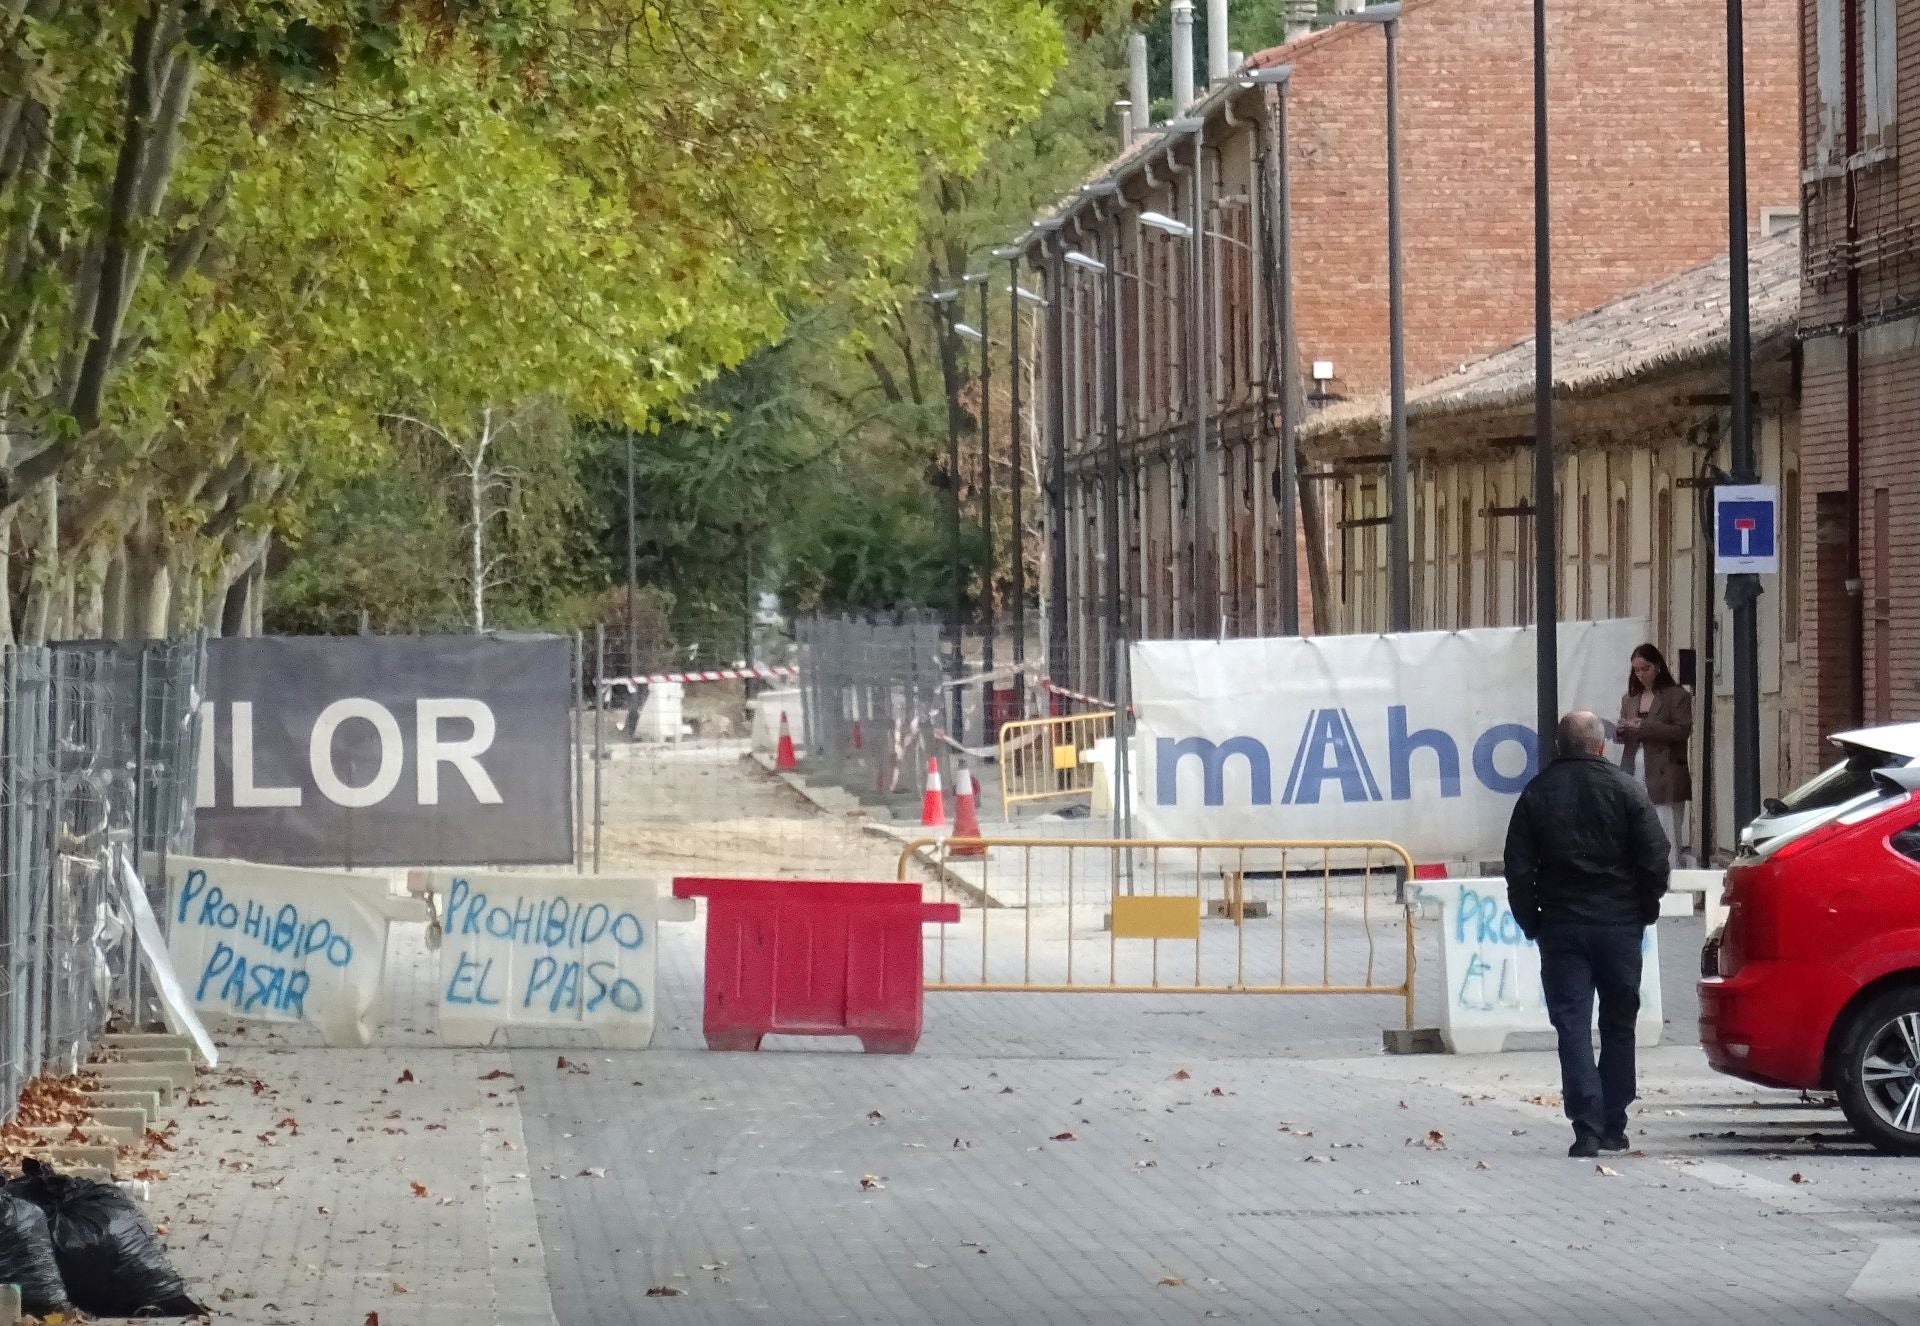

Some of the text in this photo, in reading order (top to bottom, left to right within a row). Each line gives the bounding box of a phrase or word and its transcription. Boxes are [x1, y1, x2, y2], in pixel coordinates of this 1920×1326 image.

[1156, 705, 1618, 806] mAho
[177, 869, 353, 967] PROHIBIDO
[444, 878, 643, 949] PROHIBIDO
[195, 941, 311, 1019] PASAR
[446, 952, 643, 1012] EL PASO
